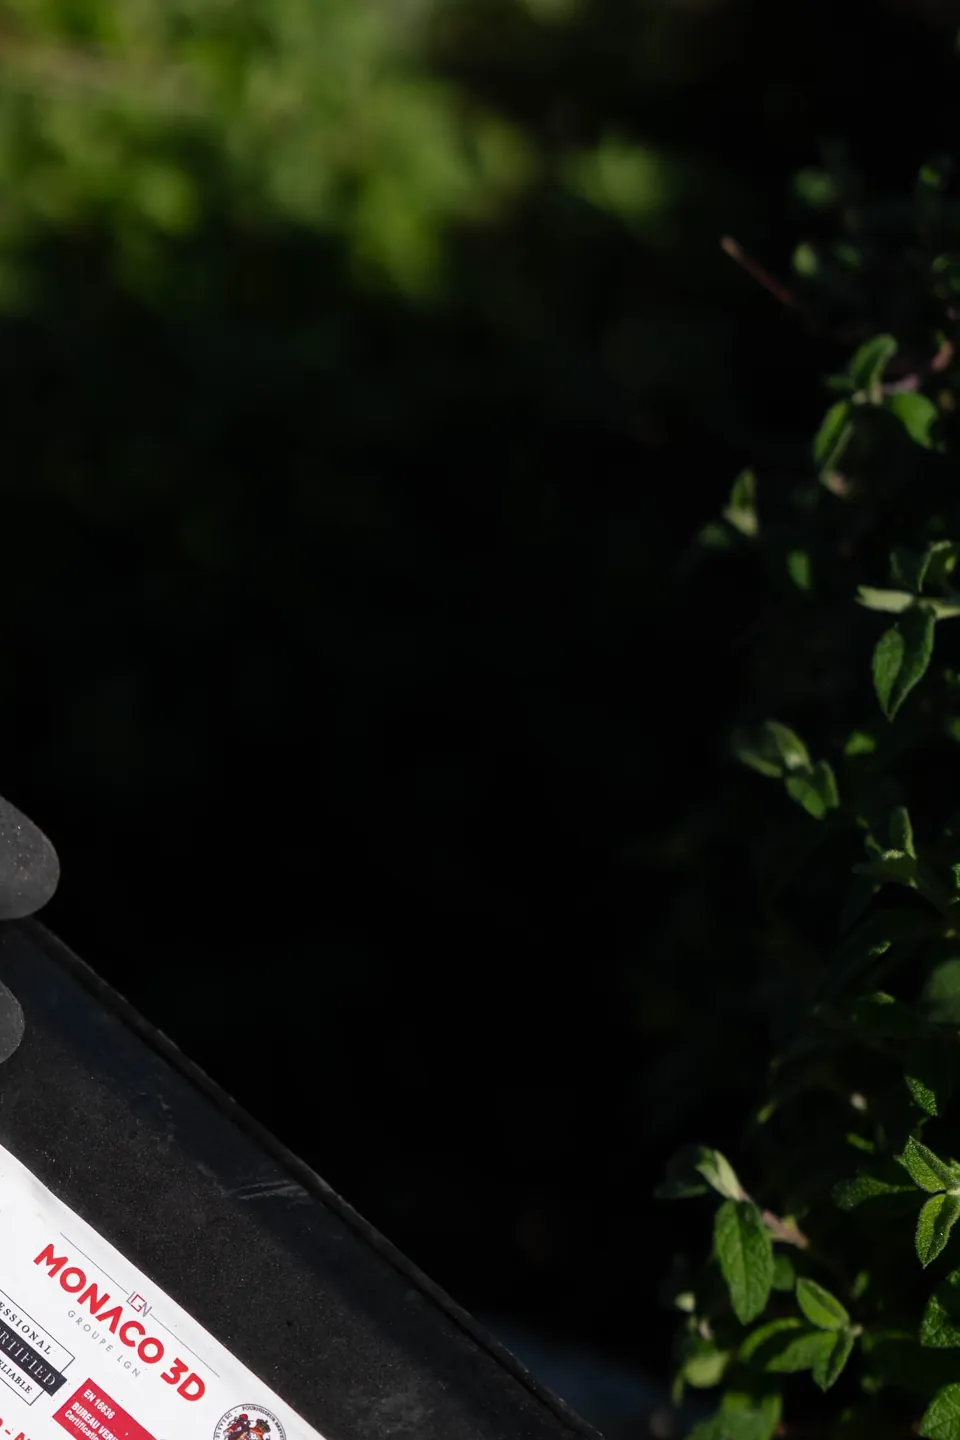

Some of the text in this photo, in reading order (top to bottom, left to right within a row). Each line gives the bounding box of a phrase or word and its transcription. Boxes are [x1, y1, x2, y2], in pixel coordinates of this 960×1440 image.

[33, 1243, 205, 1401] MONACO 3D
[67, 1309, 140, 1377] GROUPE LGN
[71, 1401, 100, 1429] BUREAU
[83, 1389, 115, 1419] EN 16636
